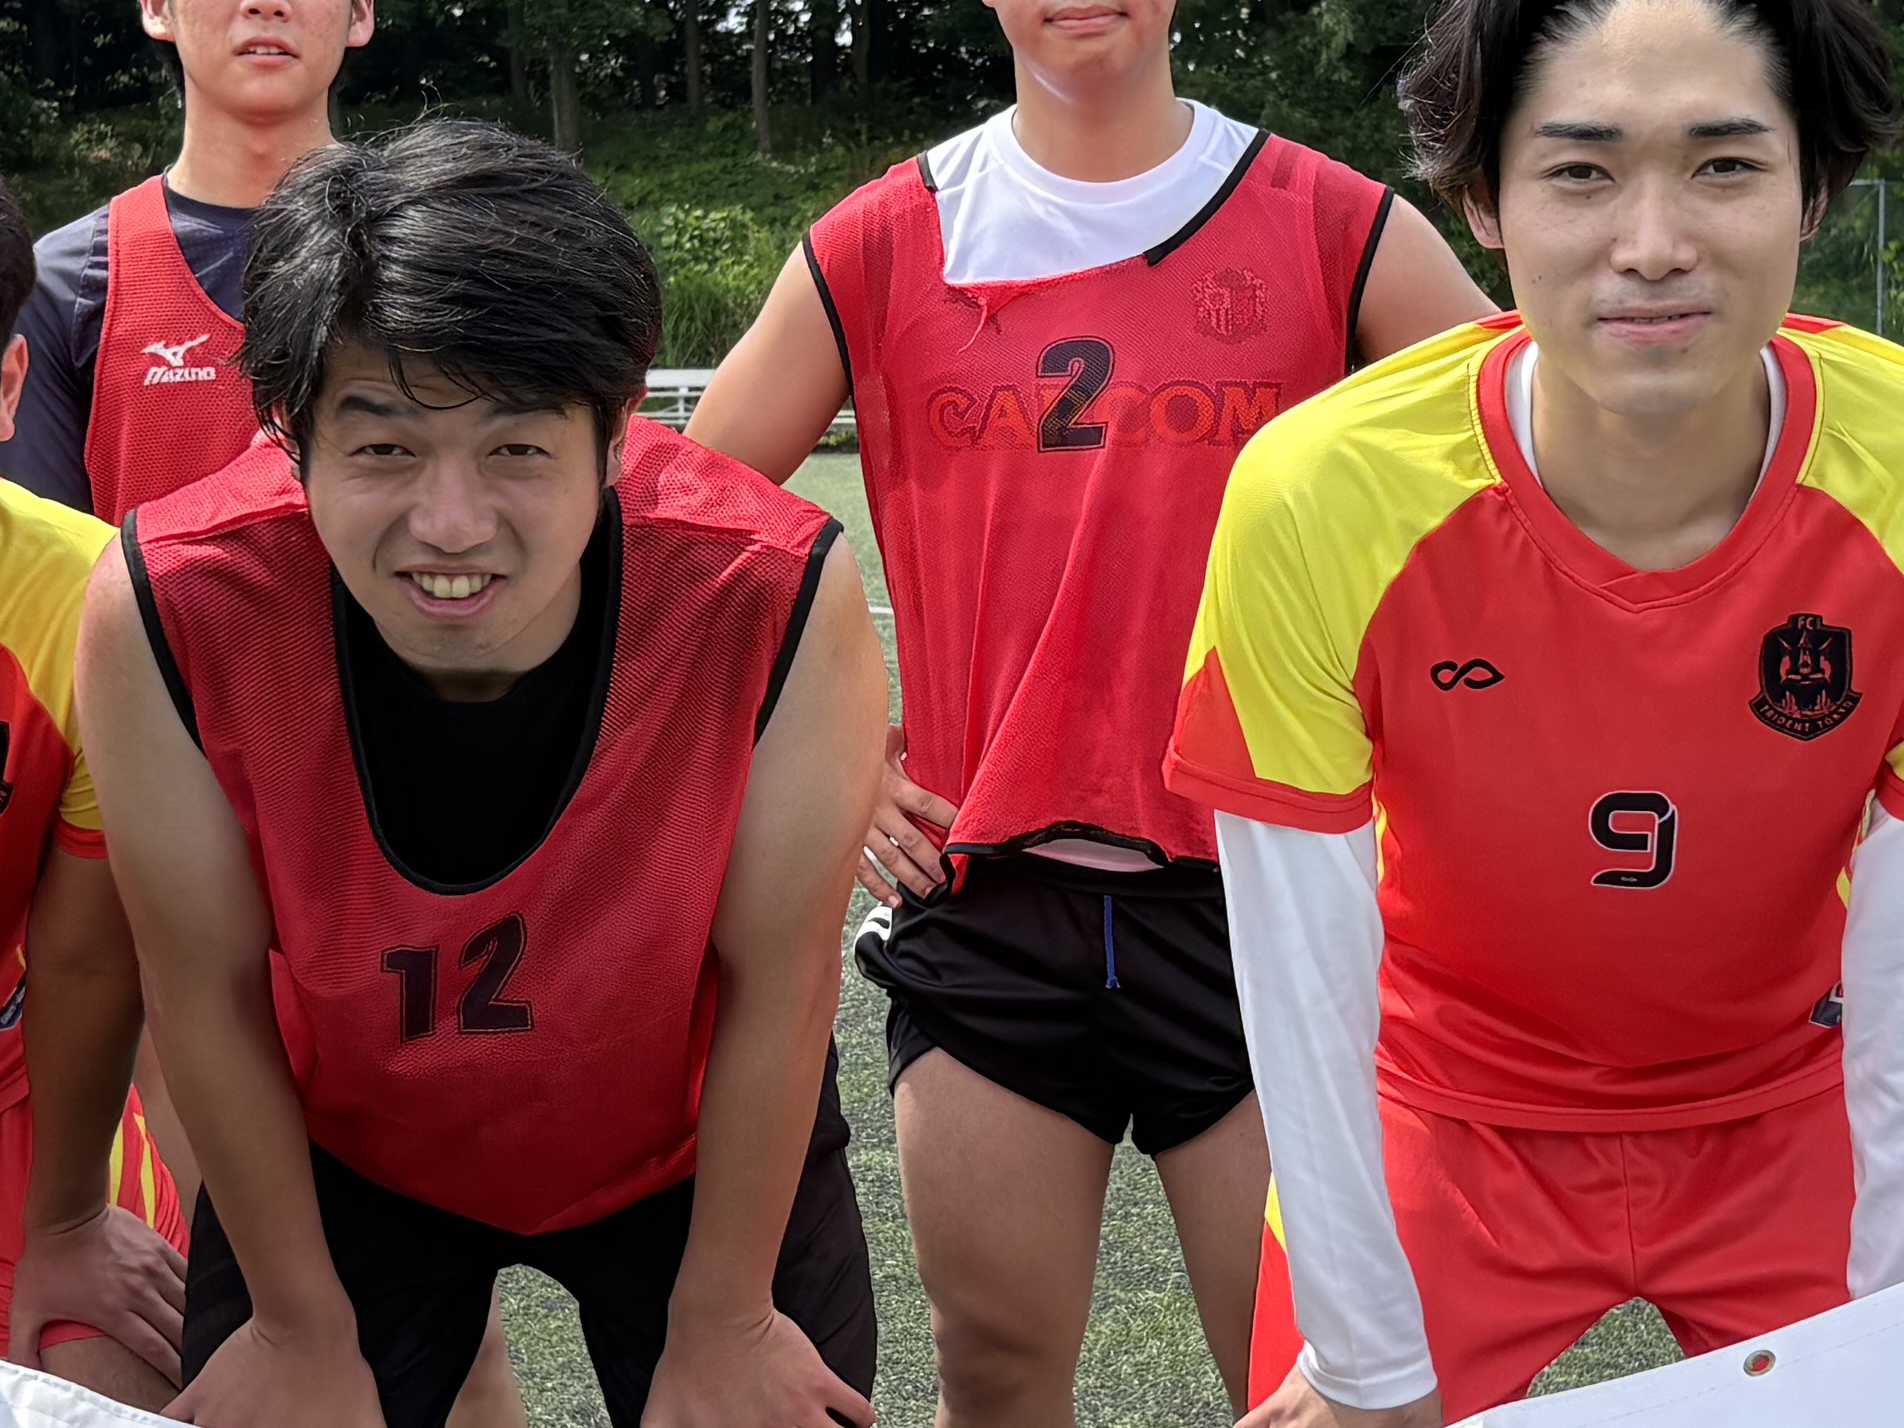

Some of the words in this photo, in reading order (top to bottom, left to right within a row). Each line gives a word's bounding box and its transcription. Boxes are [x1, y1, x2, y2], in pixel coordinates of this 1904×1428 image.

[926, 379, 1283, 451] CACOM
[1036, 335, 1115, 454] 2
[1797, 616, 1815, 631] FC
[1759, 704, 1811, 732] TRIDENT
[1587, 789, 1679, 890] 9
[380, 911, 534, 1044] 12
